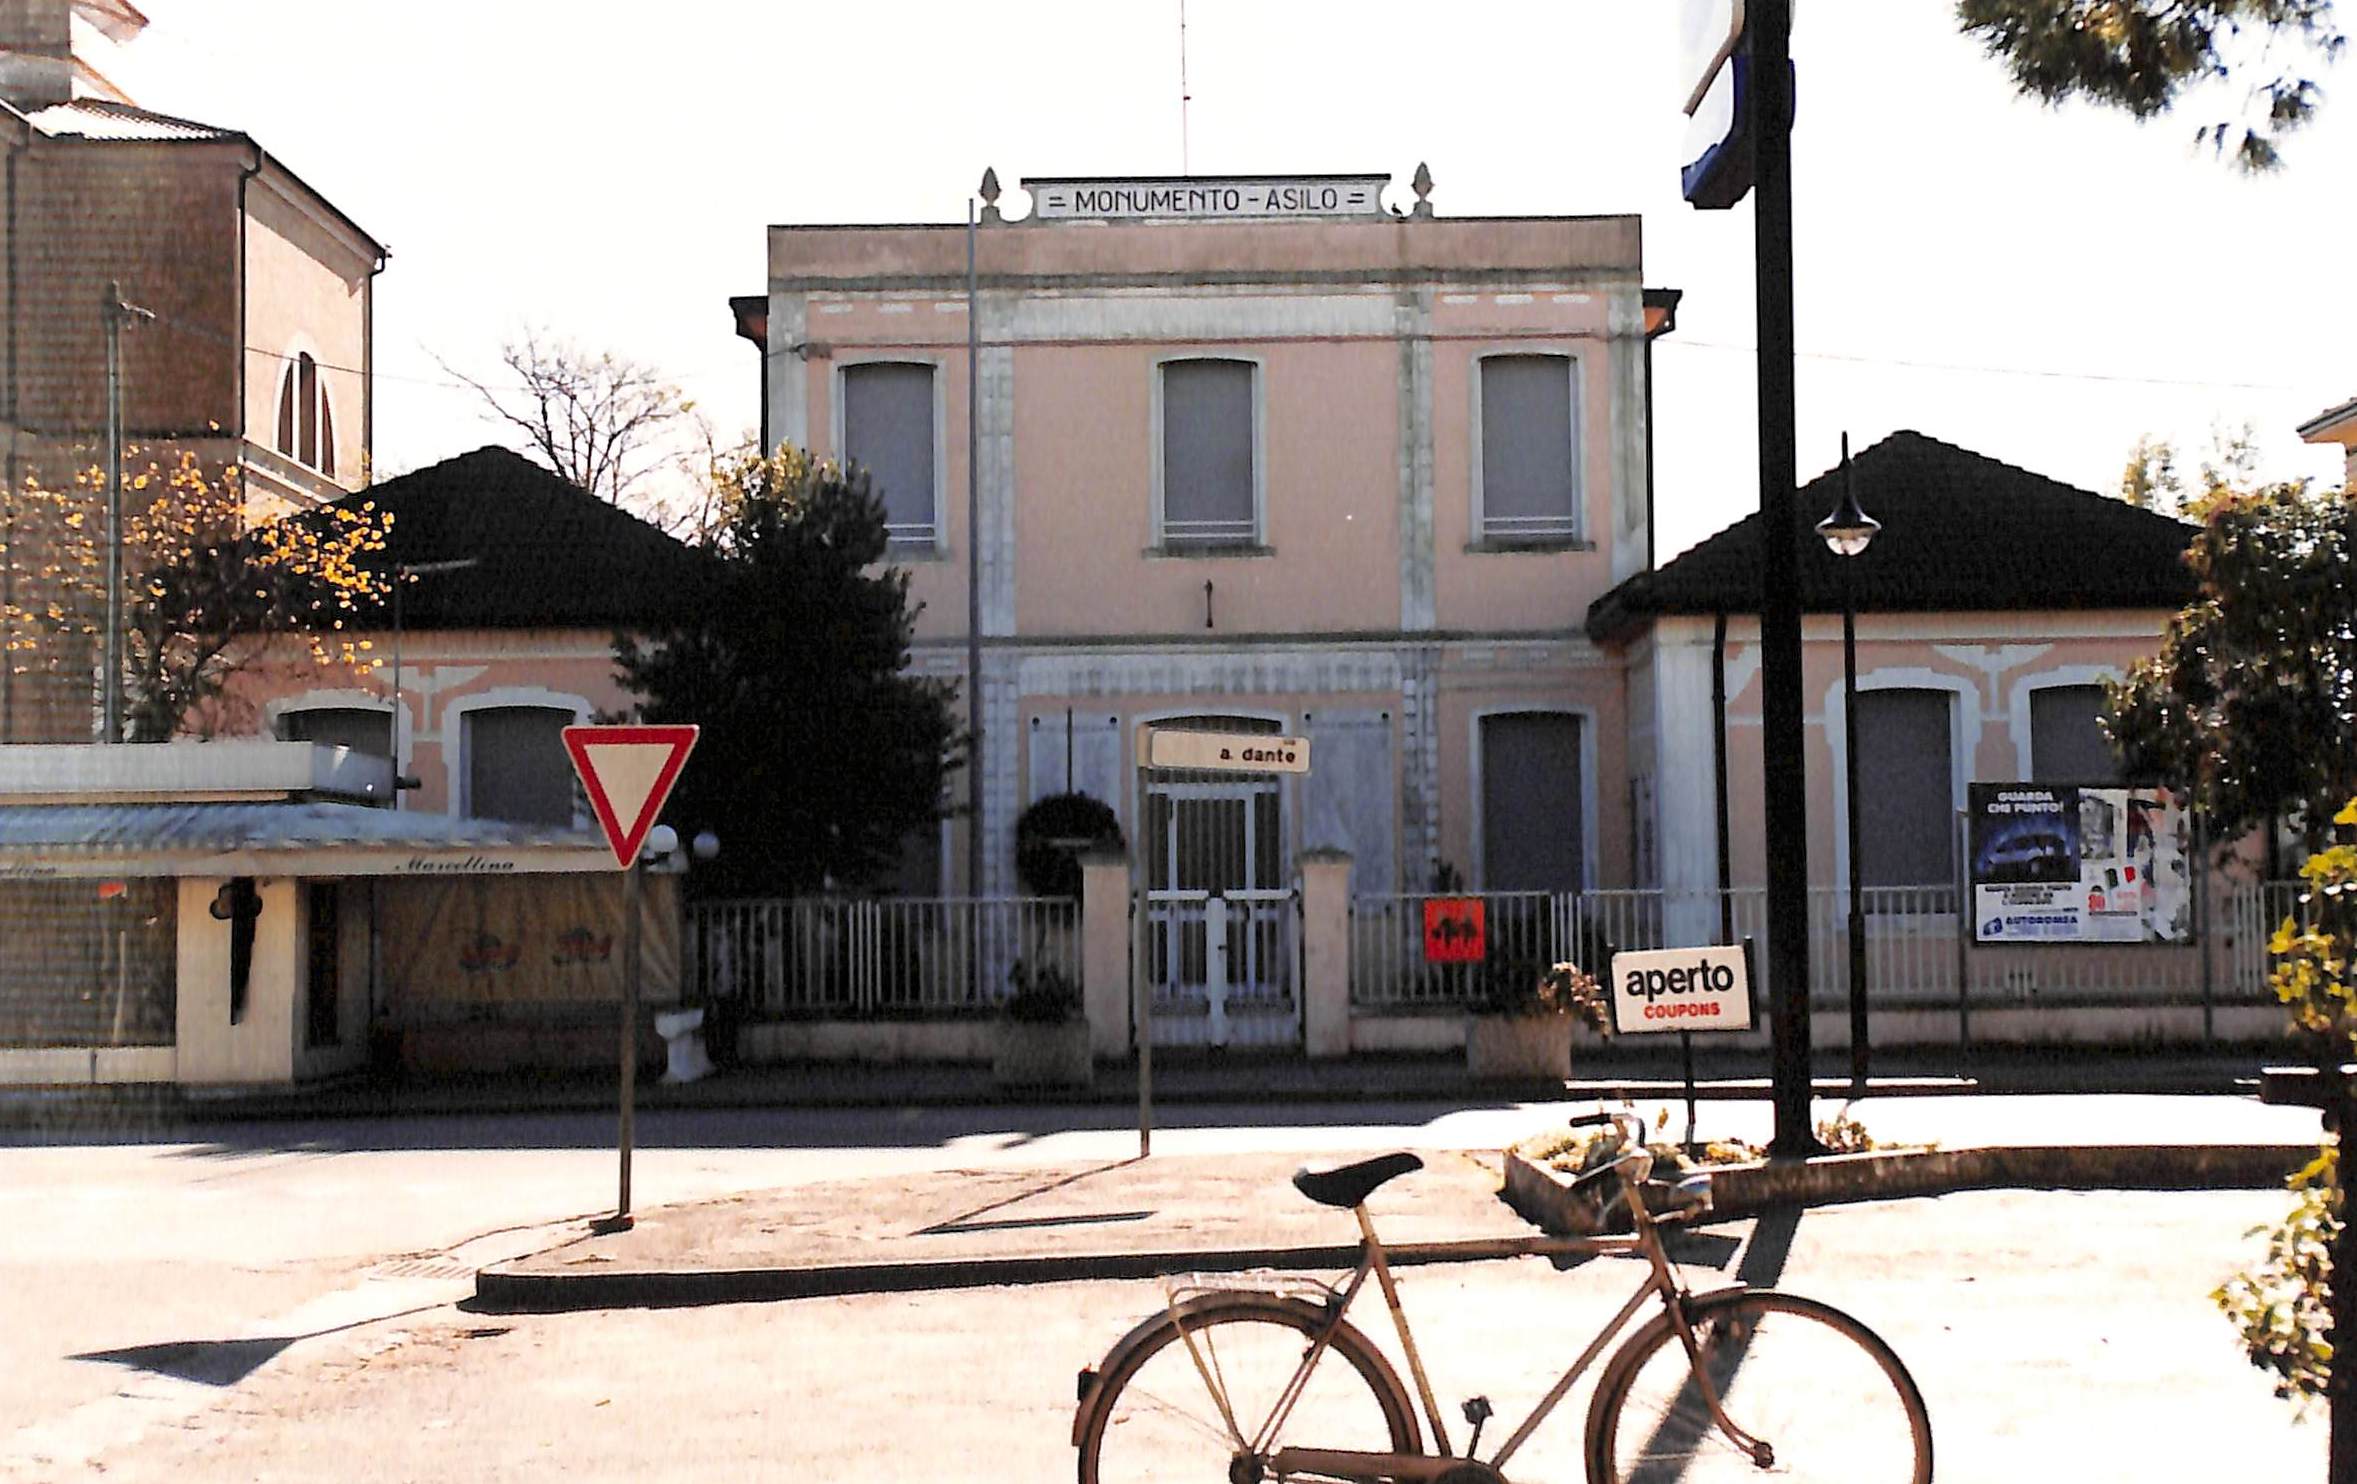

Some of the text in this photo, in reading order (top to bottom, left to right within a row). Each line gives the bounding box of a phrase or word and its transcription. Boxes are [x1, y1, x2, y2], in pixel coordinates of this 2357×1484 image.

[1075, 187, 1240, 213] MONUMENTO
[1265, 187, 1338, 212] ASILO
[1241, 748, 1296, 763] dante
[1997, 791, 2053, 801] GUARDA
[1626, 958, 1734, 1002] aperto
[1643, 1002, 1721, 1019] COUPONS
